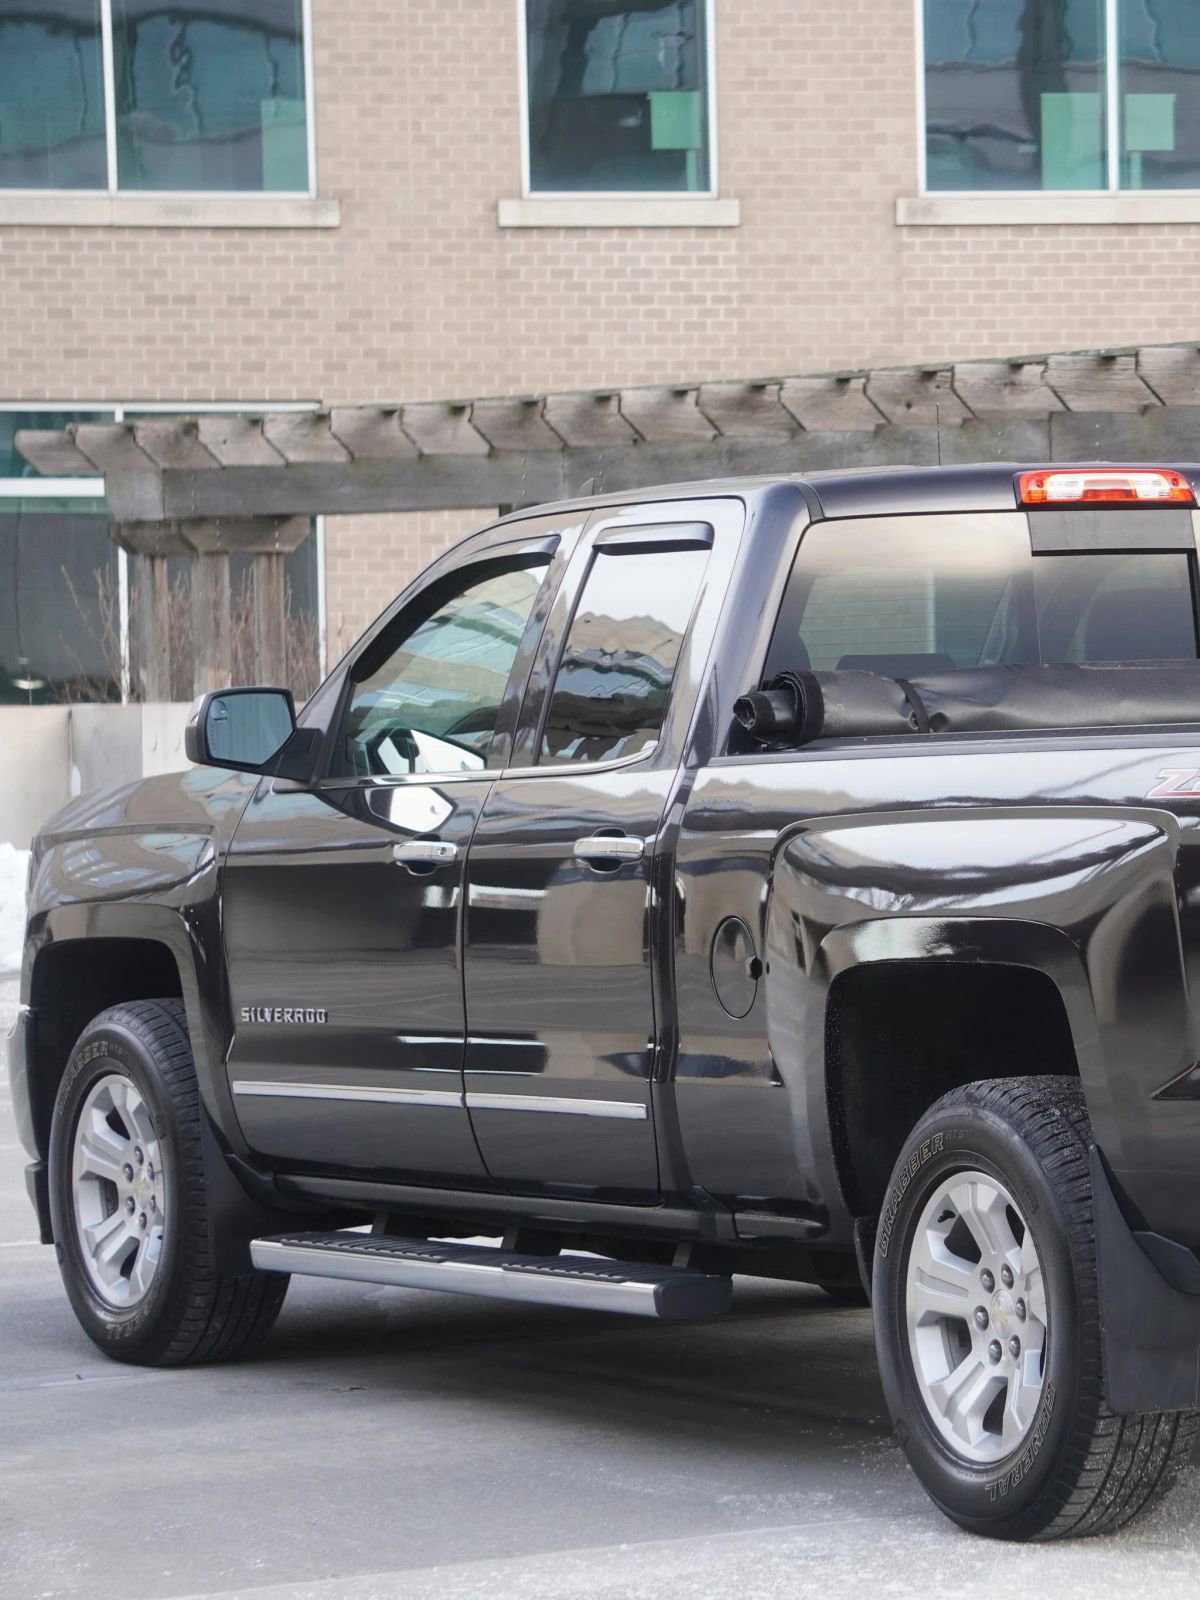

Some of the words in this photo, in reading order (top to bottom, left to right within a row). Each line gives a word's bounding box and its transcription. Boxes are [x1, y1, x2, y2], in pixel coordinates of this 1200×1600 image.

[241, 1007, 328, 1023] SILVERADO
[879, 1132, 944, 1258] GRABBER
[985, 1380, 1056, 1501] GENERAL
